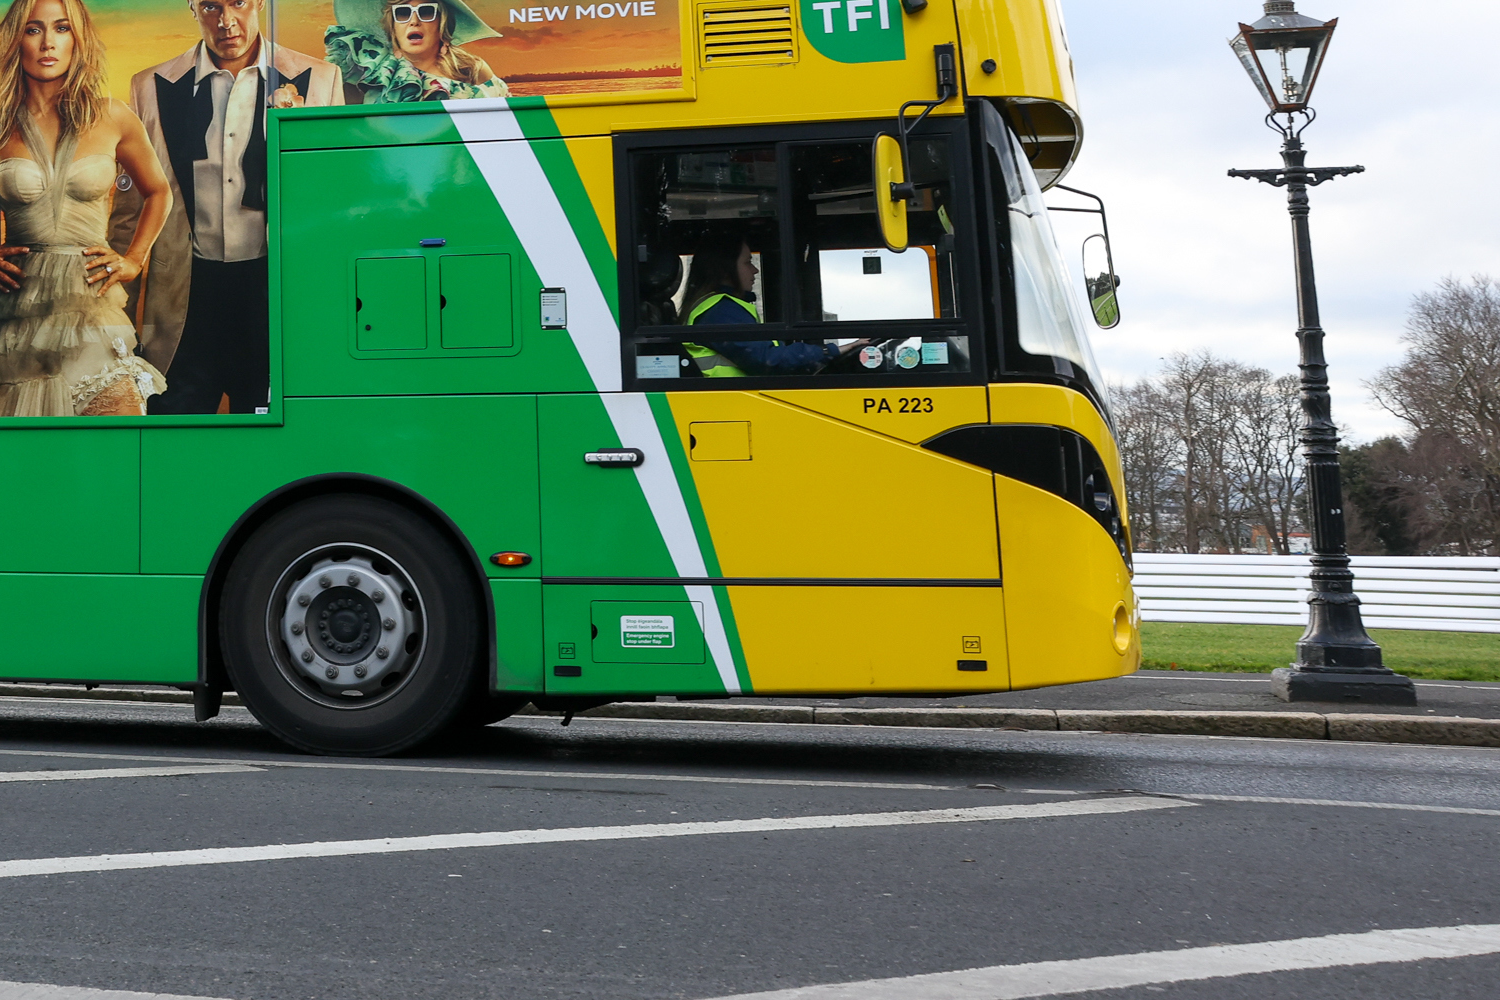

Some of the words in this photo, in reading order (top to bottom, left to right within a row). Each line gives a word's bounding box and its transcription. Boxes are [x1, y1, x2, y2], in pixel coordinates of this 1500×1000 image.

[509, 6, 569, 23] NEW
[575, 1, 656, 20] MOVIE
[863, 398, 892, 413] PA
[898, 398, 934, 413] 223
